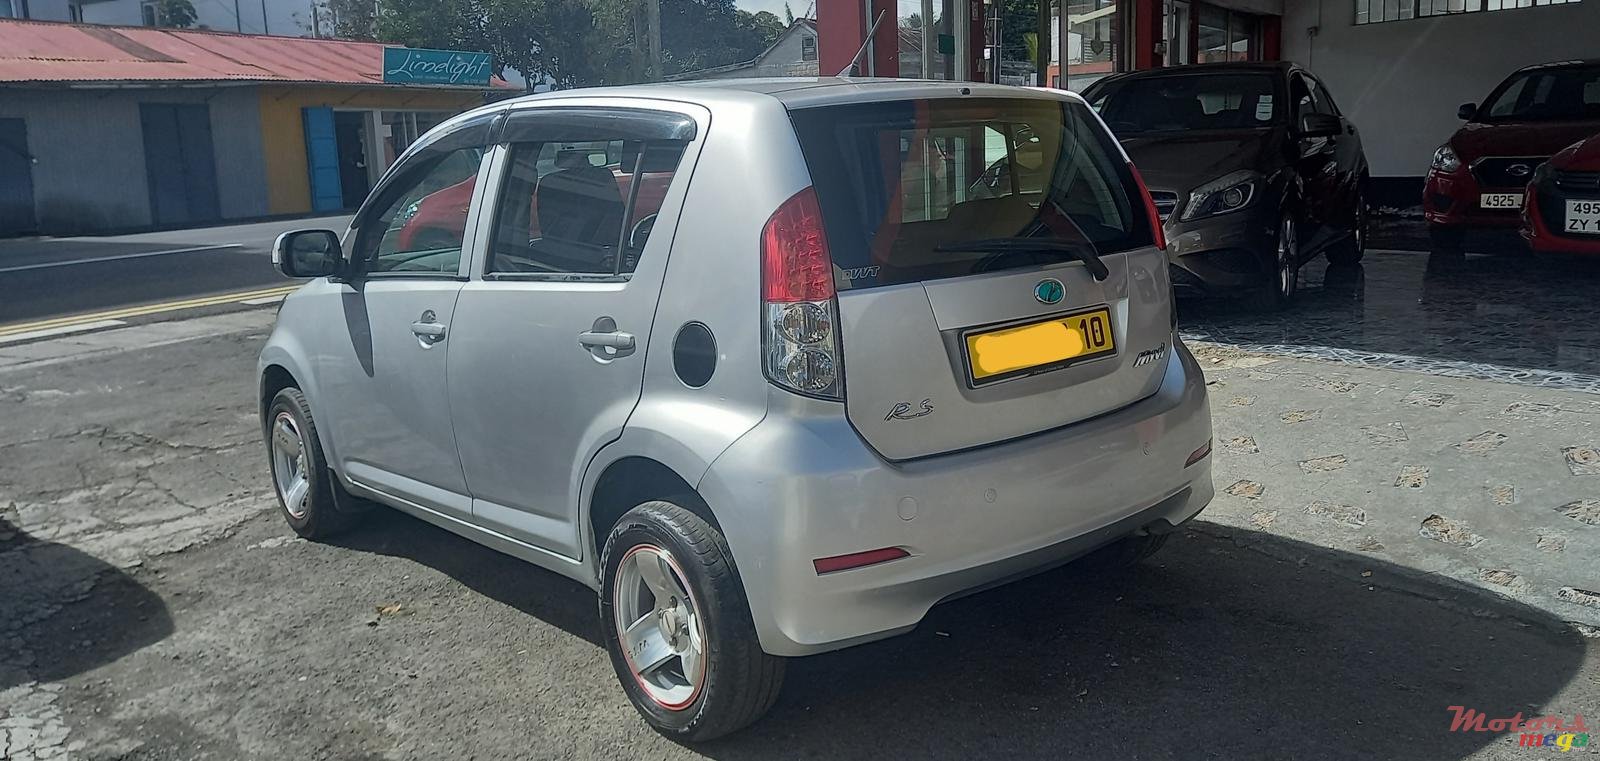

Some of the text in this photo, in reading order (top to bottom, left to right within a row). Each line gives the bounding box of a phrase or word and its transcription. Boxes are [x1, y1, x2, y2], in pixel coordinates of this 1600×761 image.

[387, 51, 489, 83] Limelight
[1485, 195, 1514, 206] 4925
[1569, 219, 1589, 230] ZY
[1080, 316, 1106, 349] 10
